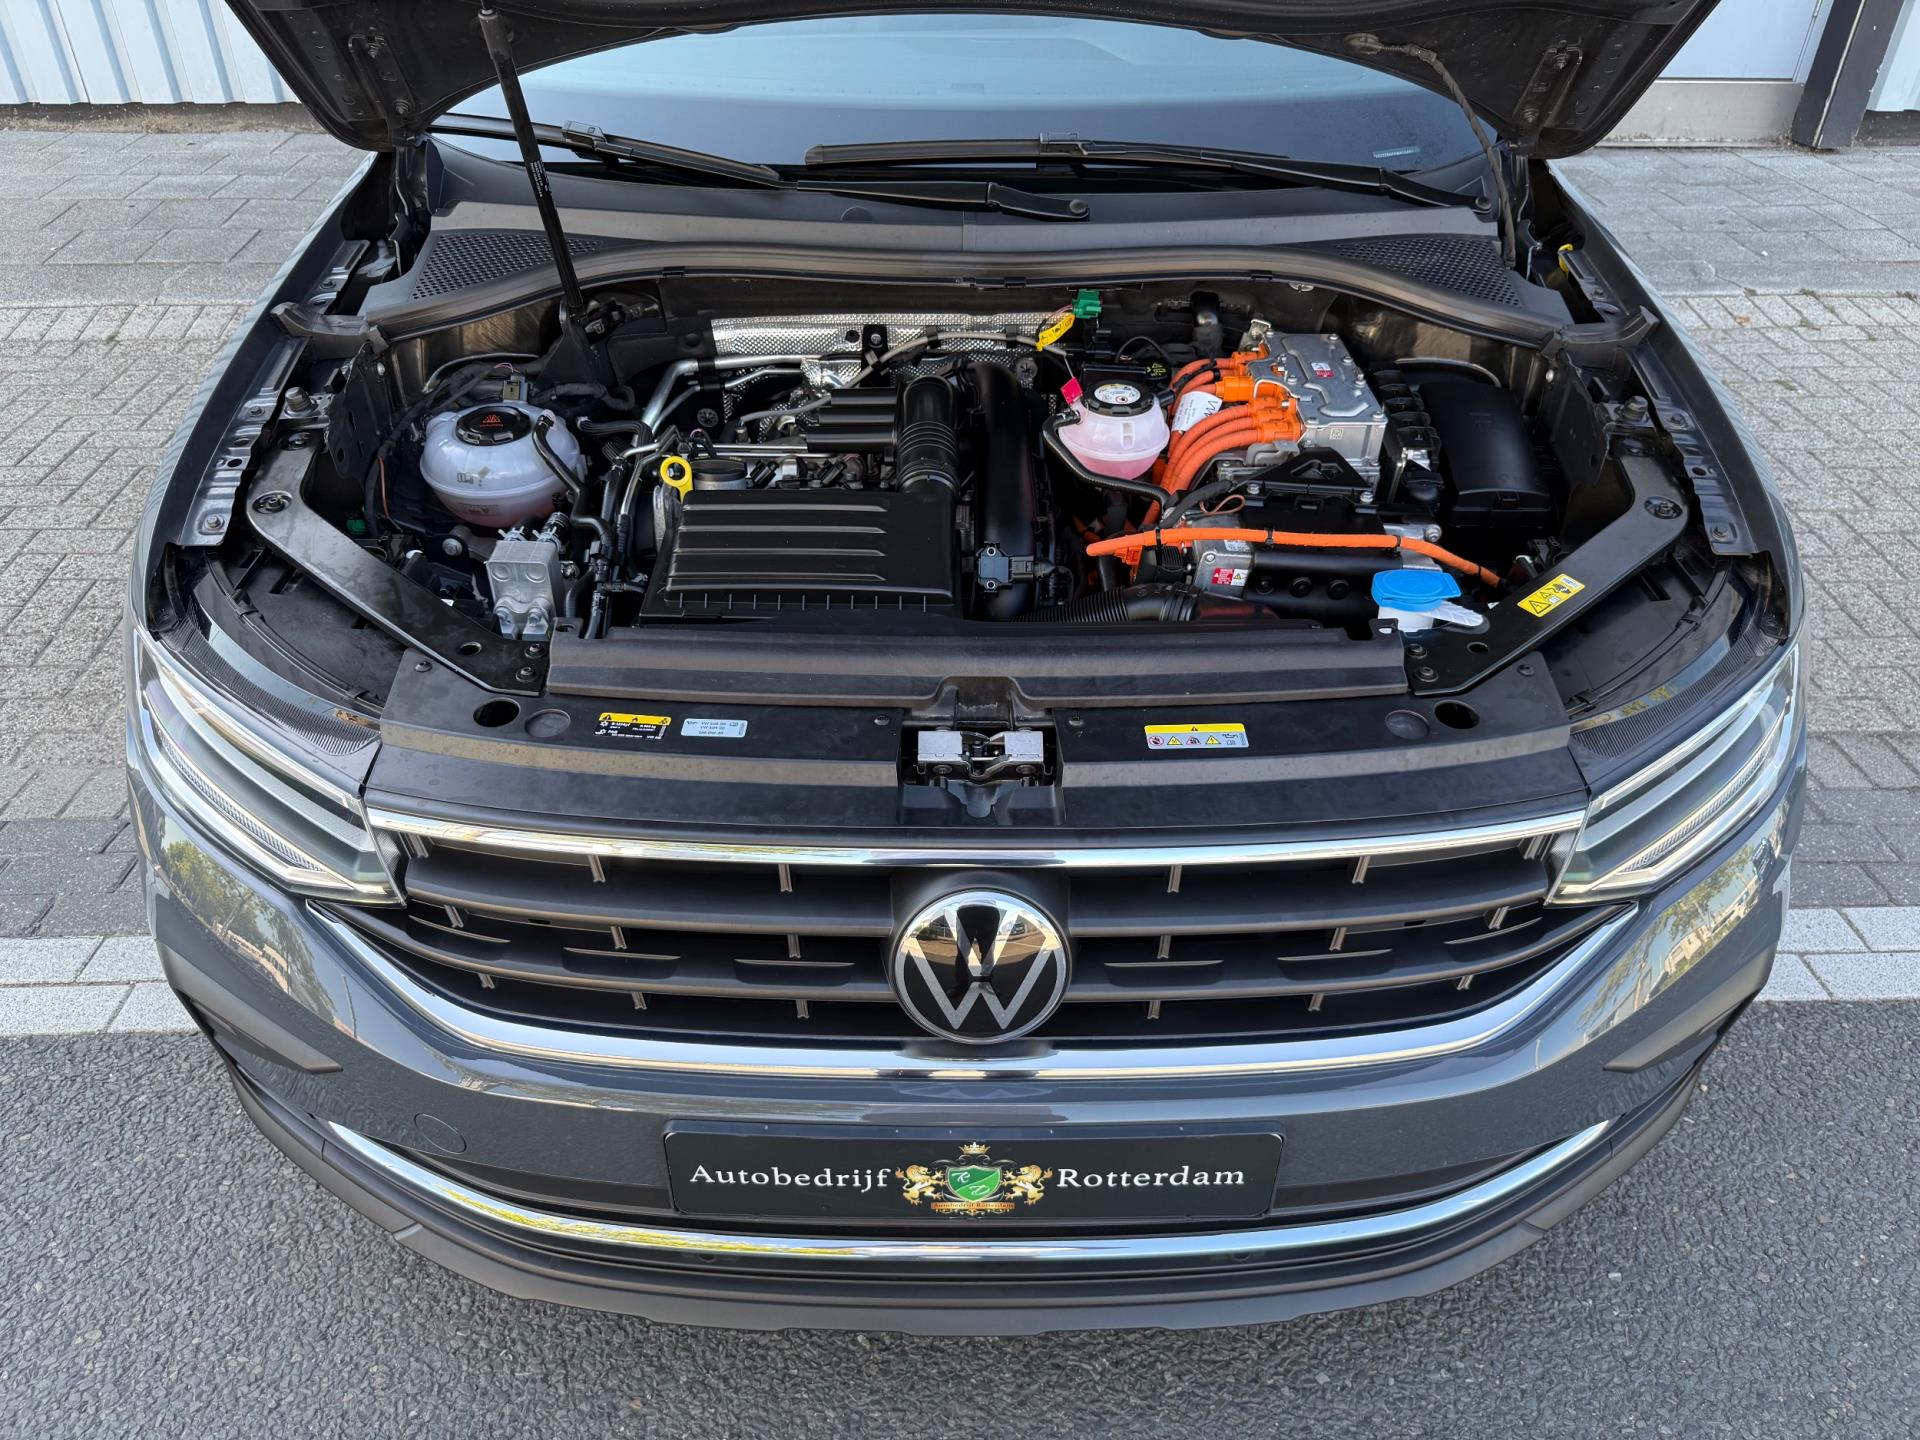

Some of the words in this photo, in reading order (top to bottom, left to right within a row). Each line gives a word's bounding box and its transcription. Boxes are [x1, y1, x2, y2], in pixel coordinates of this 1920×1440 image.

[894, 889, 1069, 1042] VW
[689, 1164, 892, 1193] Autobedrijf
[1056, 1165, 1245, 1188] Rotterdam
